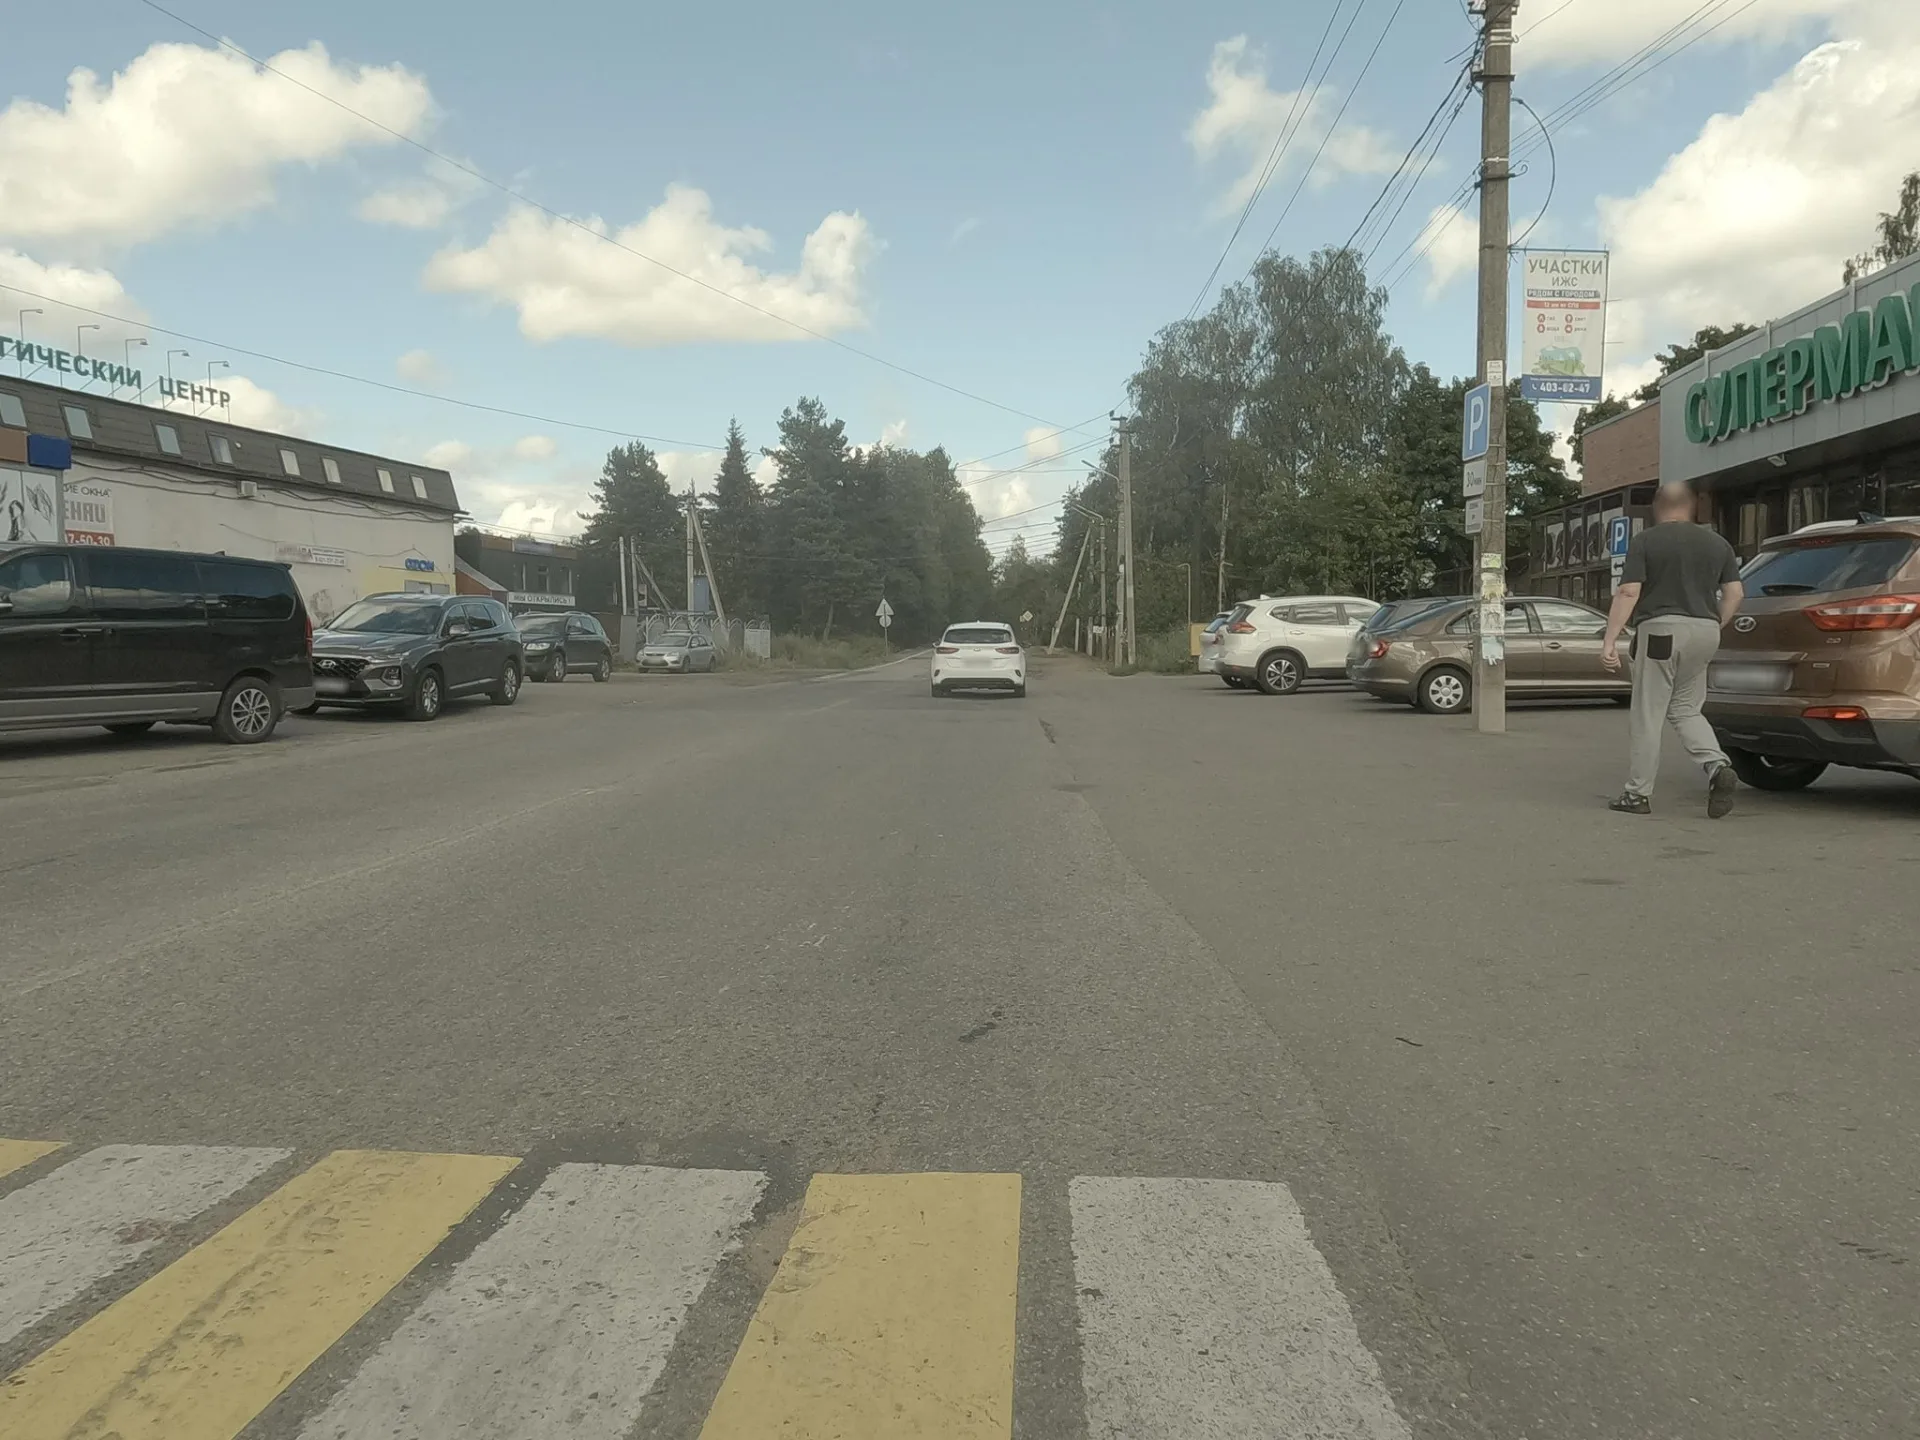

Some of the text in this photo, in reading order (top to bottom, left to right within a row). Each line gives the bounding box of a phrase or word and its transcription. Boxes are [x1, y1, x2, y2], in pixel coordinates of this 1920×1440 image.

[1528, 259, 1603, 275] УЧАСТКИ
[1552, 276, 1578, 287] ИЖС
[159, 375, 230, 408] ЦЕНТР
[1469, 395, 1484, 451] P
[1614, 522, 1625, 552] P
